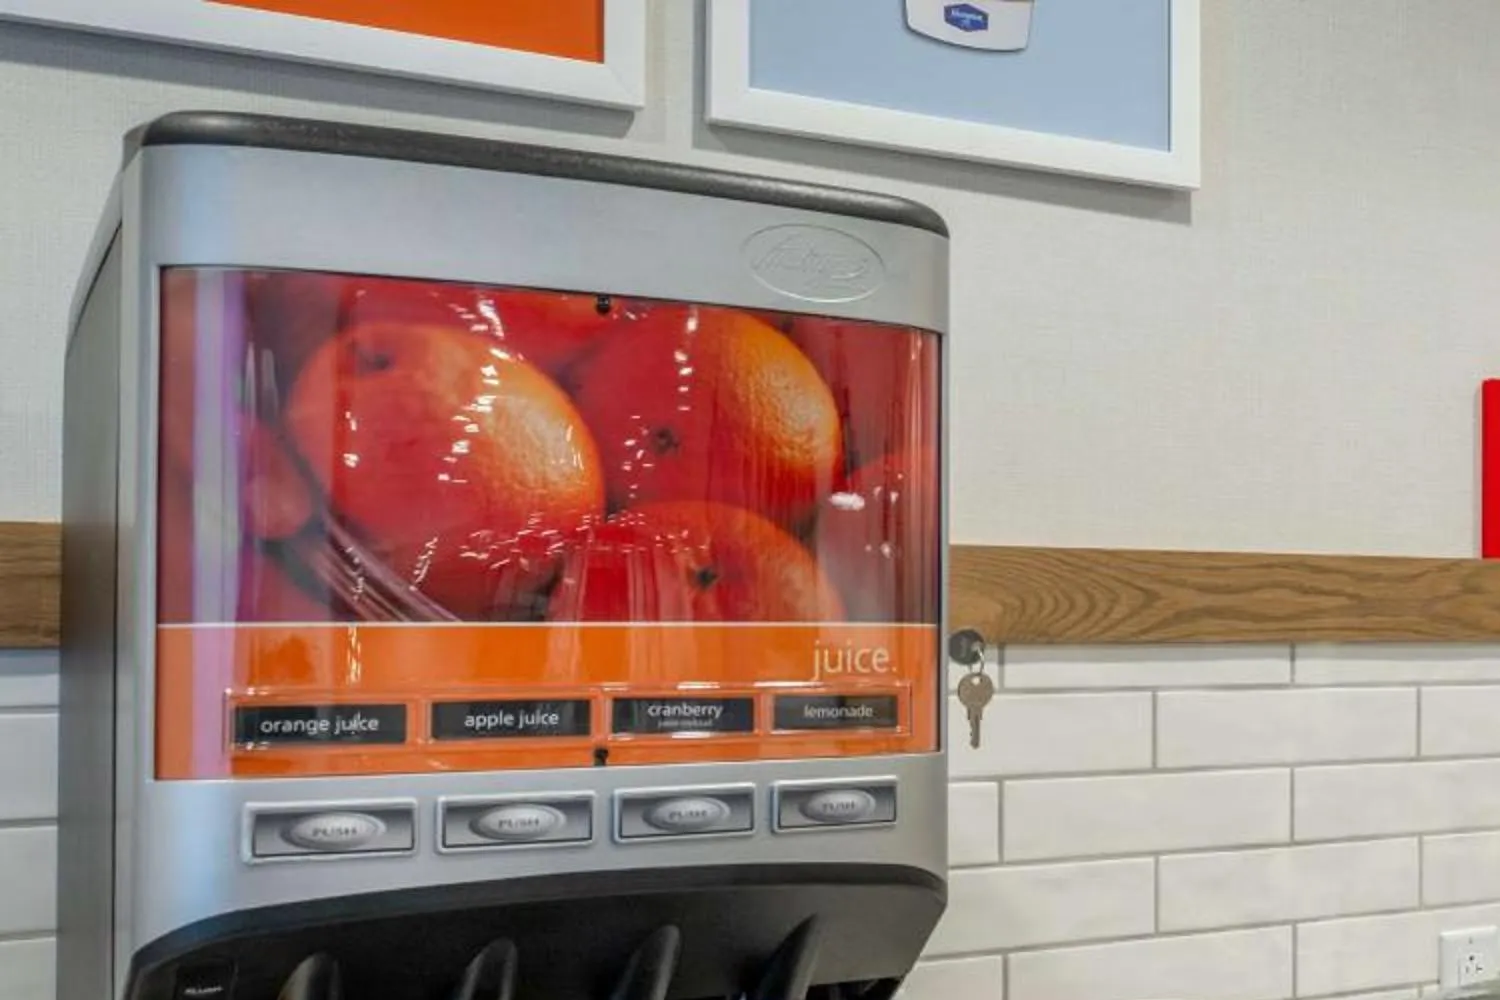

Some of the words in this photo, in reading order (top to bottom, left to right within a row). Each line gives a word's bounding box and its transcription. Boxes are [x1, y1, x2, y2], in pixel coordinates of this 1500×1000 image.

[810, 639, 898, 681] juice.
[647, 702, 724, 719] cranberry
[803, 704, 874, 719] lemonade
[259, 717, 330, 735] orange
[333, 713, 380, 735] juice
[463, 709, 516, 731] apple
[517, 708, 560, 730] juice
[498, 817, 541, 828] PUSH
[668, 809, 708, 820] PUSH
[311, 827, 358, 838] PUSH
